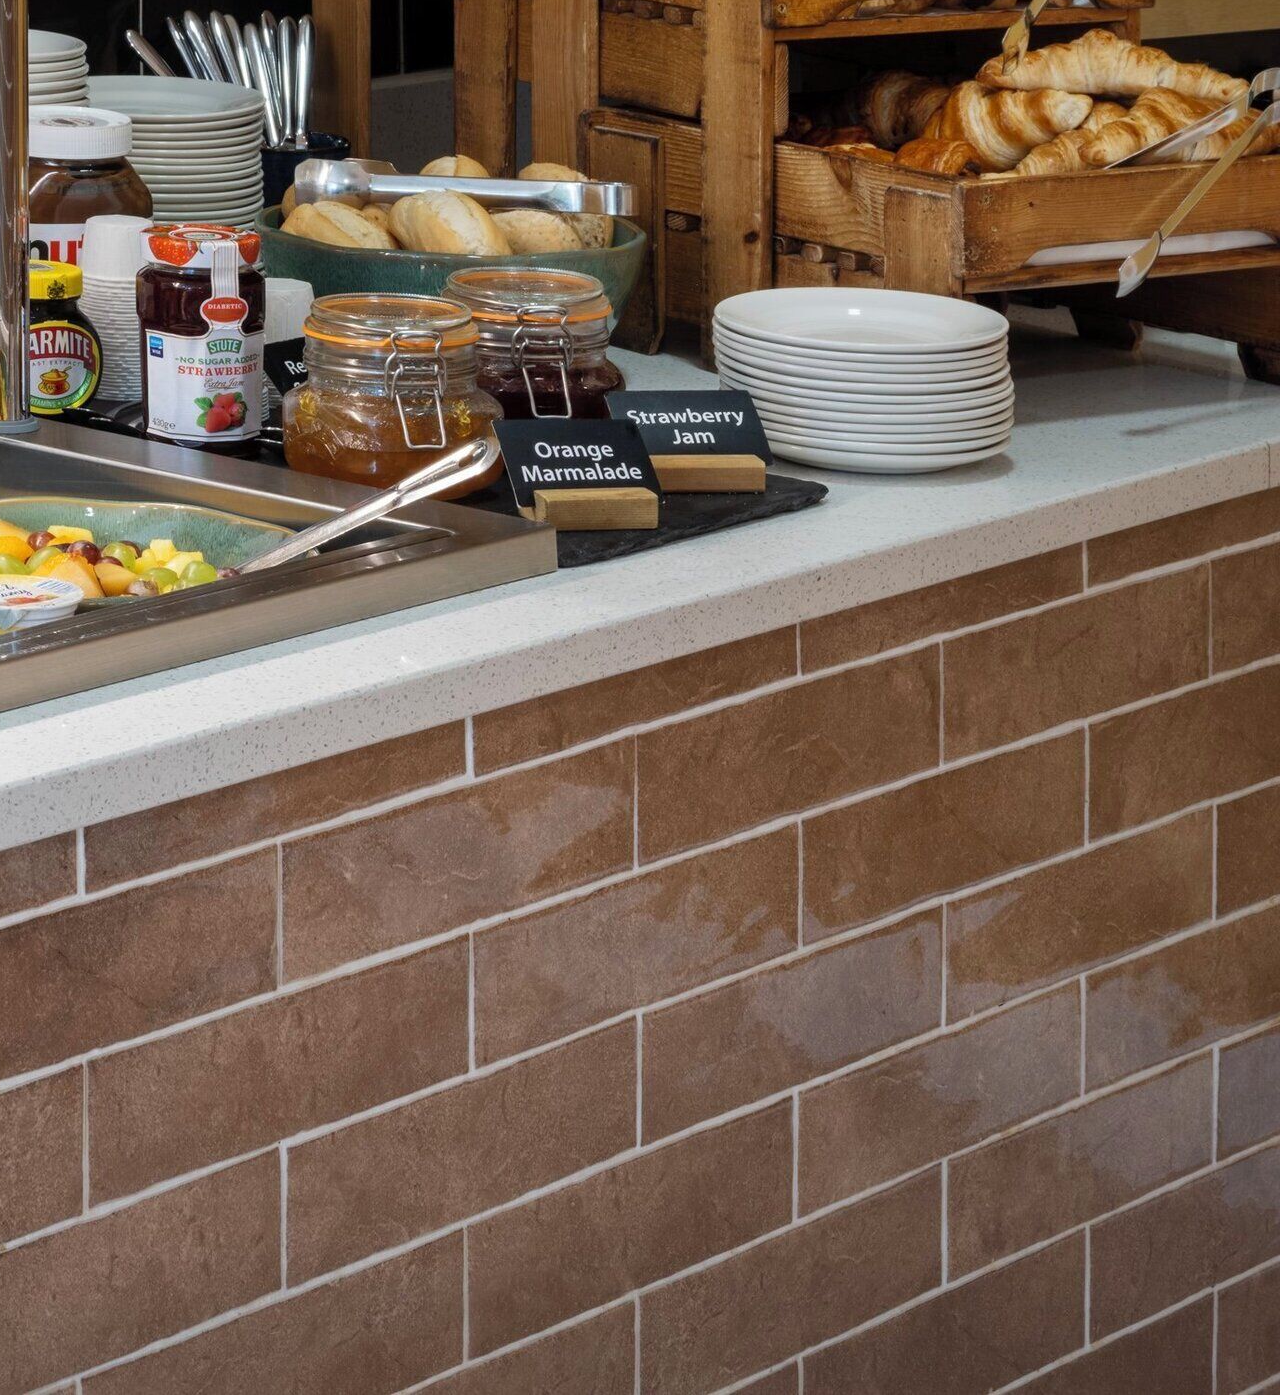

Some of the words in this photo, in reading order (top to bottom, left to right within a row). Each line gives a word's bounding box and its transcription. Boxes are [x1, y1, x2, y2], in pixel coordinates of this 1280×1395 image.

[30, 330, 90, 359] ARMITE
[210, 340, 239, 353] STUTE
[198, 357, 232, 365] SUGAR
[284, 360, 308, 375] Re
[177, 362, 259, 377] STRAWBERRY
[204, 378, 227, 390] Extra
[227, 378, 245, 389] Jam
[627, 408, 744, 426] Strawberry
[672, 429, 716, 445] Jam
[535, 442, 614, 461] Orange
[521, 462, 642, 483] Marmalade
